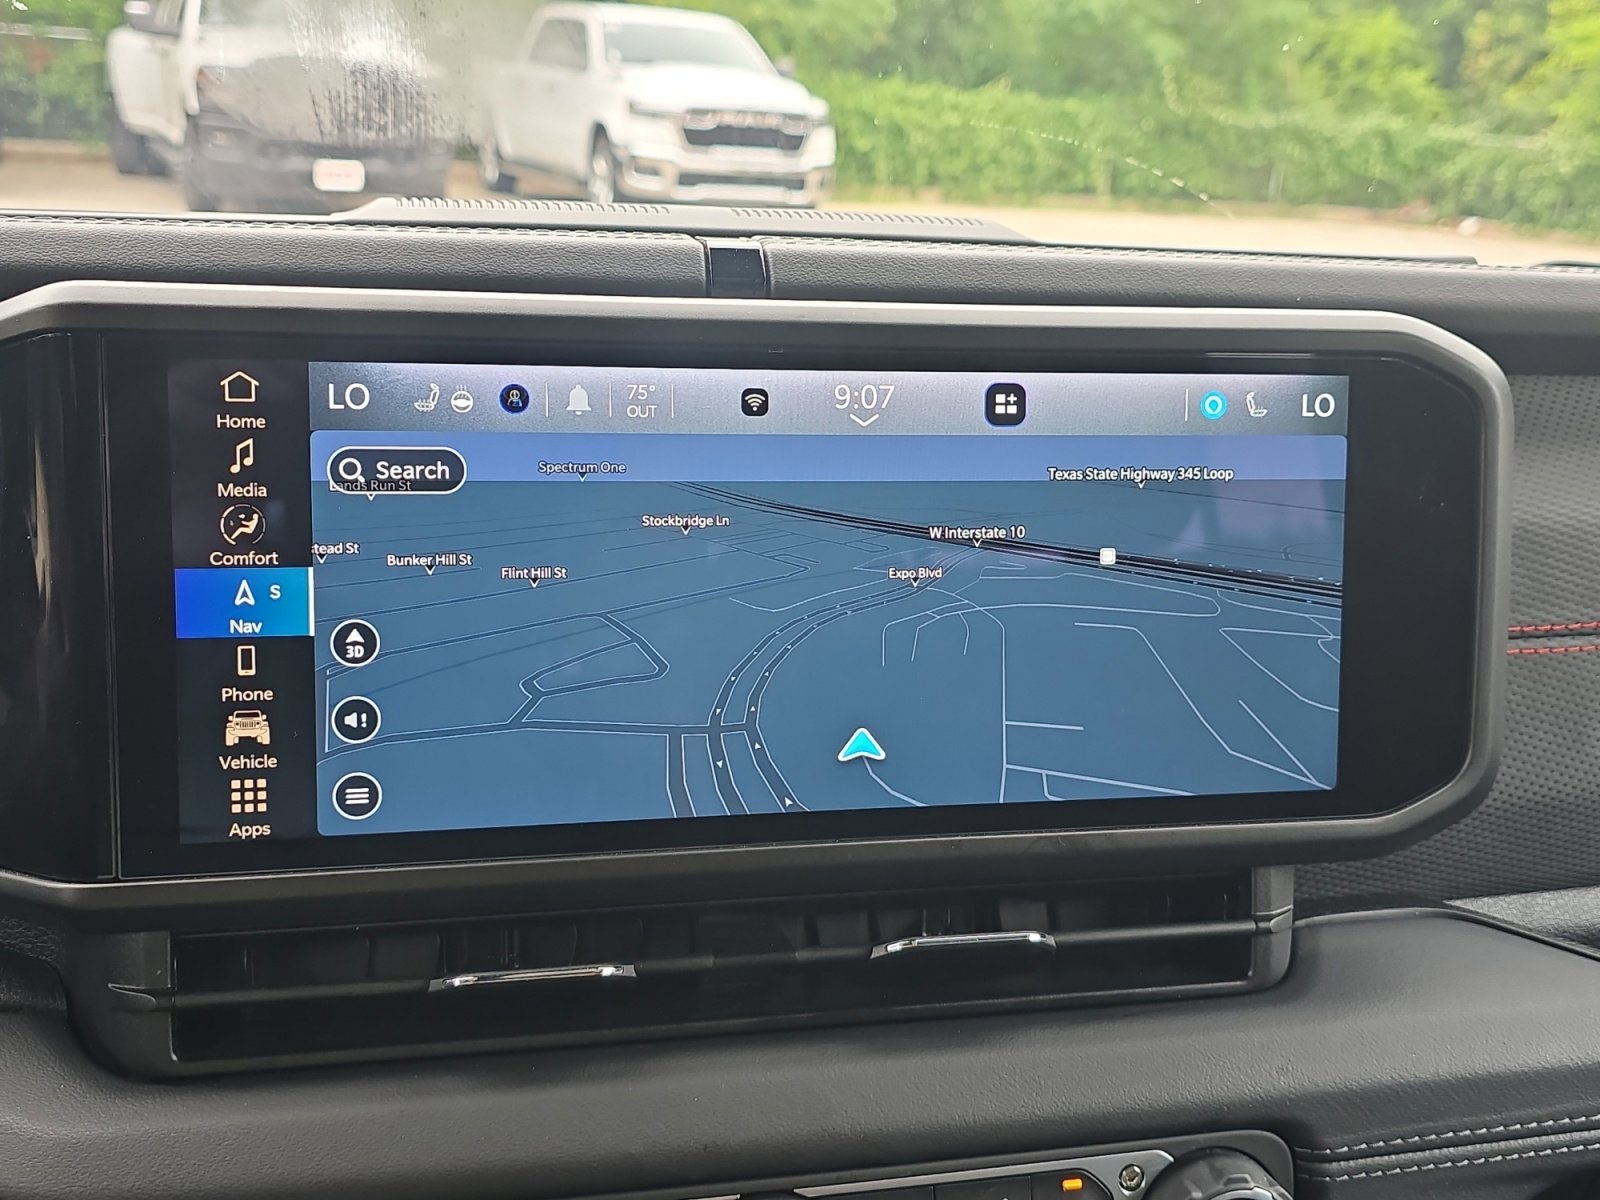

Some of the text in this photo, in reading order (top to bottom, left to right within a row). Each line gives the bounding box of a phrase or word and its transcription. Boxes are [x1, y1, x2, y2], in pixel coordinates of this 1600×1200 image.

[328, 383, 370, 410] LO
[834, 384, 895, 410] 9:07
[626, 405, 657, 418] OUT
[1301, 393, 1335, 417] LO
[216, 414, 266, 429] Home
[376, 461, 450, 480] Search
[538, 461, 626, 475] Spectrum One
[1048, 467, 1234, 482] Texas State Highway 345 Loop
[217, 483, 268, 498] Media
[370, 480, 396, 492] Run
[398, 480, 412, 492] St
[641, 514, 730, 529] Stockbridge Ln
[928, 526, 1026, 540] W Interstate 10
[345, 542, 360, 555] St
[209, 551, 279, 566] Comfort
[387, 554, 473, 567] Bunker Hill St
[501, 567, 567, 580] Flint Hill St
[888, 567, 942, 582] Expo Blvd
[269, 584, 282, 599] S
[229, 619, 263, 634] Nav
[345, 645, 365, 659] 3D
[221, 687, 274, 702] Phone
[219, 754, 278, 769] Vehicle
[228, 822, 271, 839] Apps
